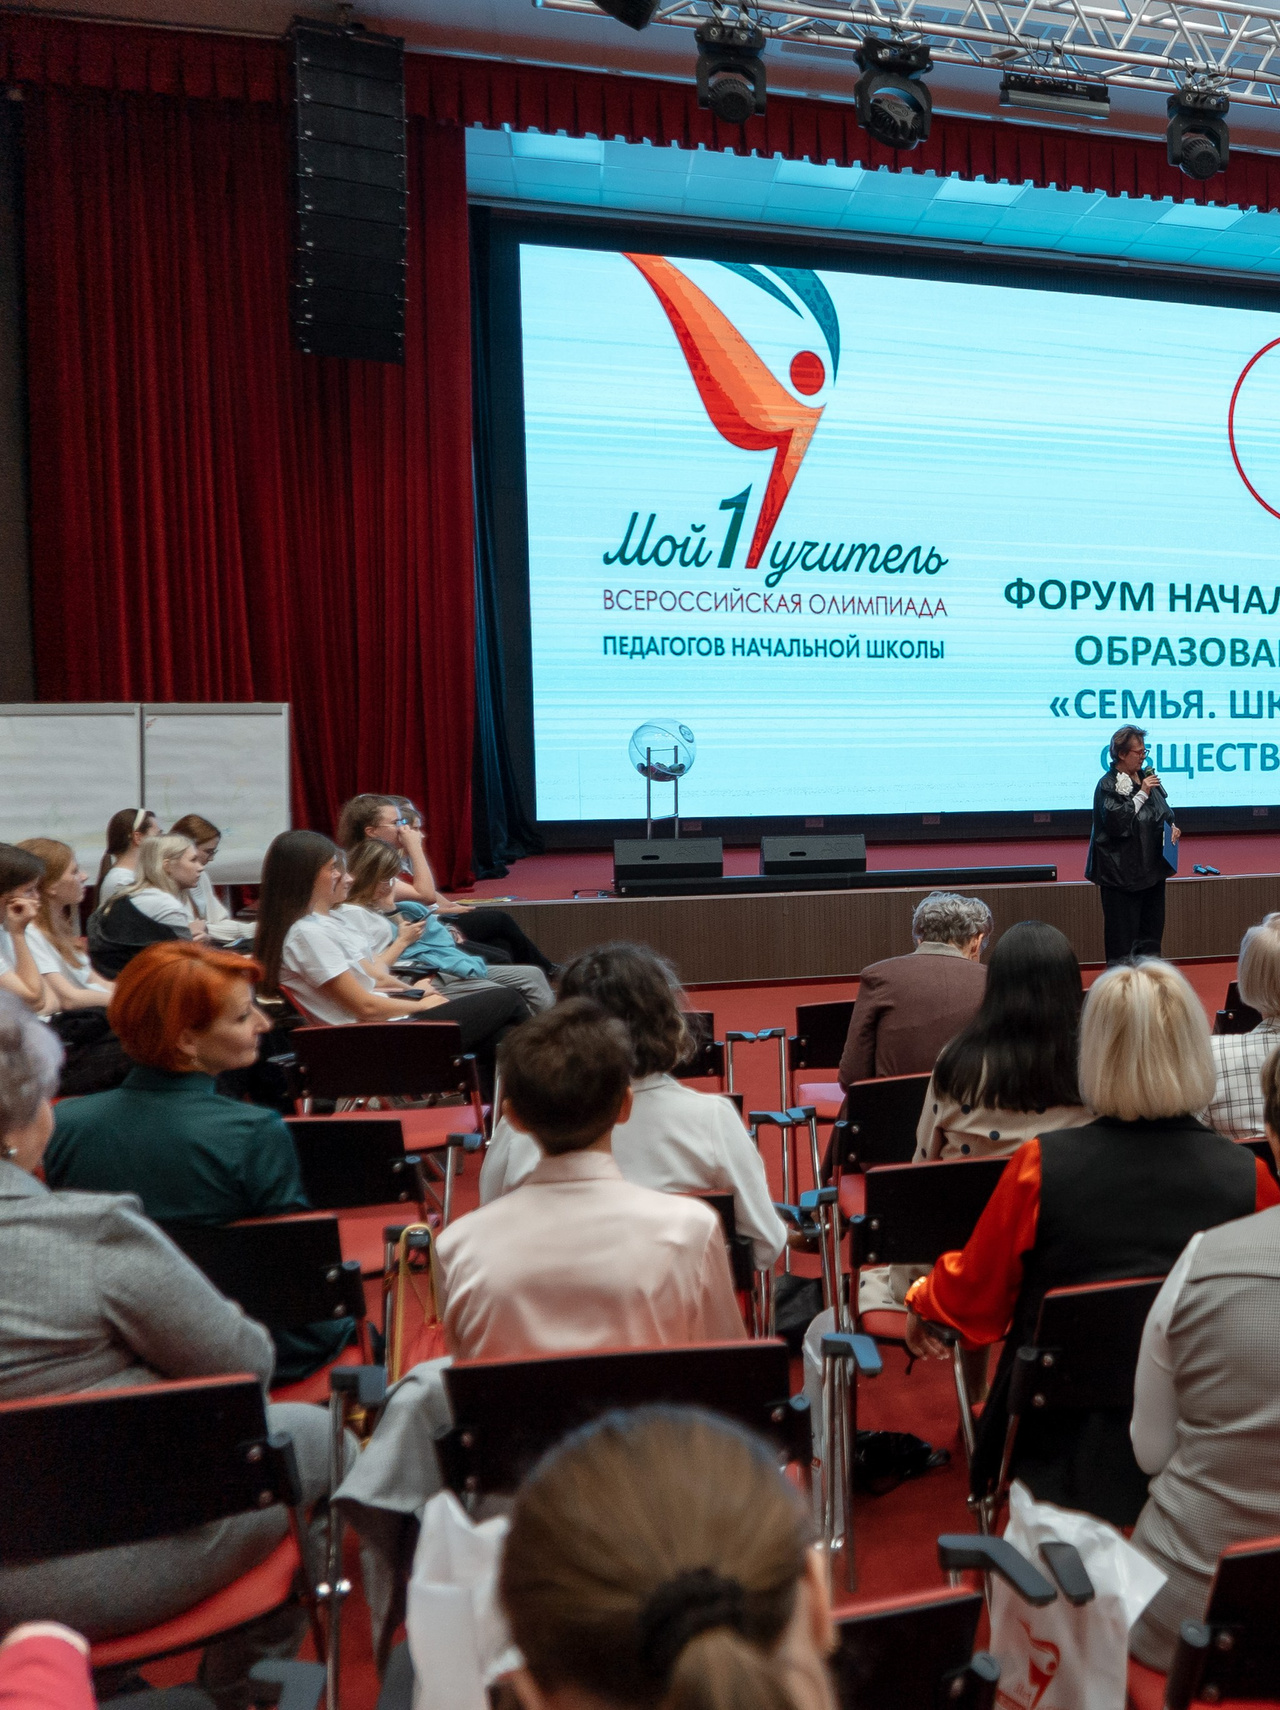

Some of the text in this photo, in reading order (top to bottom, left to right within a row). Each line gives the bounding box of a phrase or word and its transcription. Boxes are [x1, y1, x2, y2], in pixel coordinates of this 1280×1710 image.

[603, 512, 713, 567] Мой
[765, 541, 949, 588] учитель
[603, 588, 948, 619] ВСЕРОССИЙСКАЯ ОЛИМПИАДА
[1004, 577, 1154, 612] ФОРУМ
[603, 634, 945, 660] ПЕДАГОГОВ НАЧАЛЬНОЙ ШКОЛЫ
[1049, 689, 1216, 719] «СЕМЬЯ.
